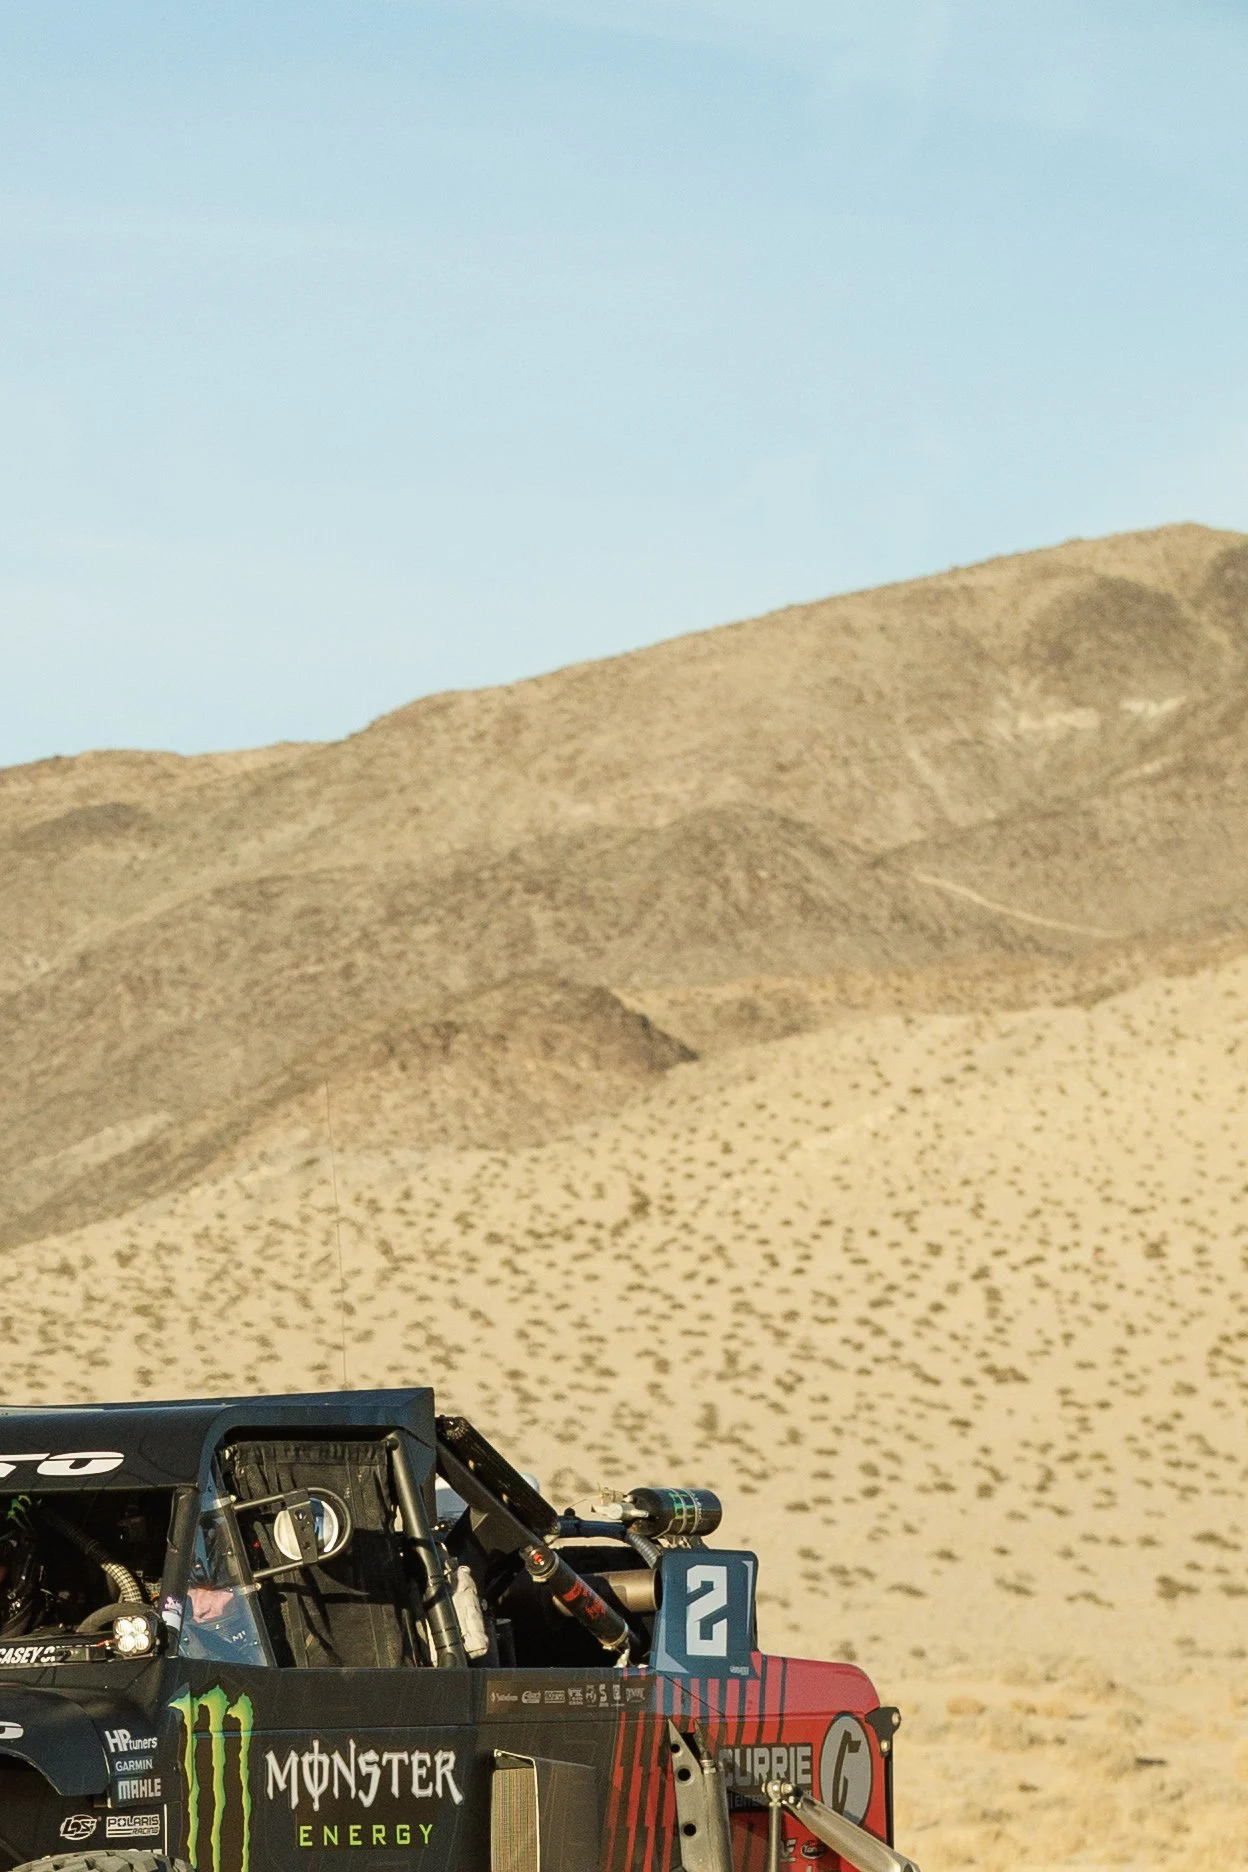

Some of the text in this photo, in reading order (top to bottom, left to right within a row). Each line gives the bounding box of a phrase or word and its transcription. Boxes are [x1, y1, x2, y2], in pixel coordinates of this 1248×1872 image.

[686, 1564, 728, 1657] 2
[115, 1759, 153, 1772] GARMIN
[265, 1738, 463, 1811] MONSTER
[718, 1746, 812, 1786] CURRIE
[117, 1778, 161, 1800] MAHLE
[107, 1815, 160, 1828] POLARIS
[132, 1826, 159, 1835] RACING
[299, 1824, 433, 1846] ENERGY
